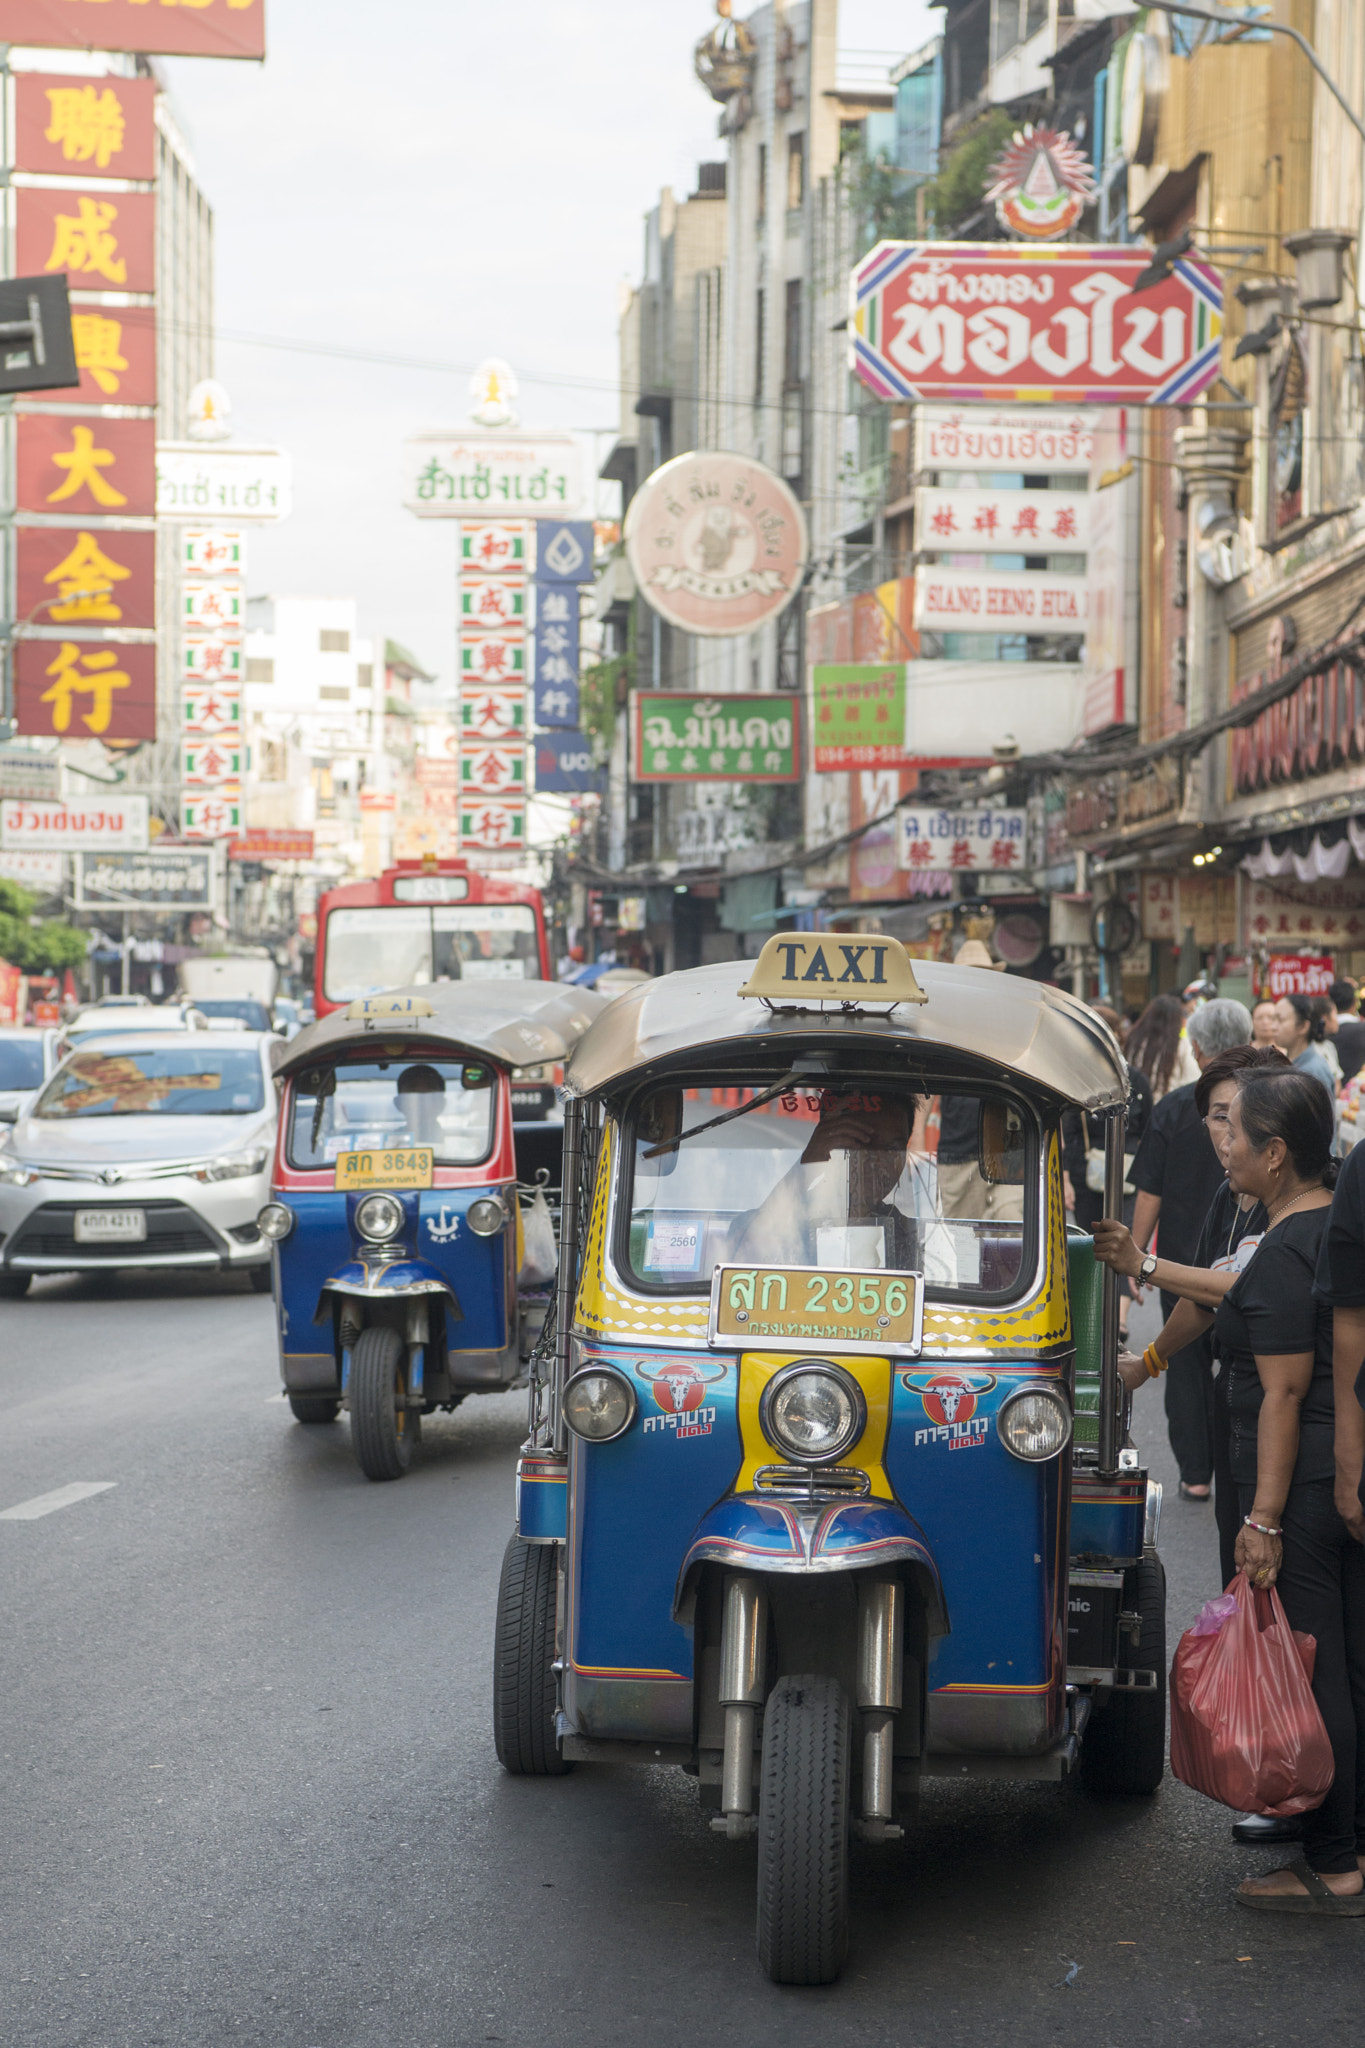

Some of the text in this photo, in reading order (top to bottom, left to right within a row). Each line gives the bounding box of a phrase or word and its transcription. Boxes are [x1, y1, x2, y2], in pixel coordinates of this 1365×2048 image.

[926, 585, 1078, 618] SIANG HENG HUA
[776, 943, 889, 984] TAXI
[383, 1152, 428, 1170] 3643
[670, 1236, 697, 1247] 2560
[729, 1271, 907, 1317] สก 2356
[643, 1406, 716, 1433] คาราบาว
[677, 1423, 712, 1438] แดง
[914, 1417, 989, 1446] คาราบาว
[949, 1433, 984, 1451] แดง
